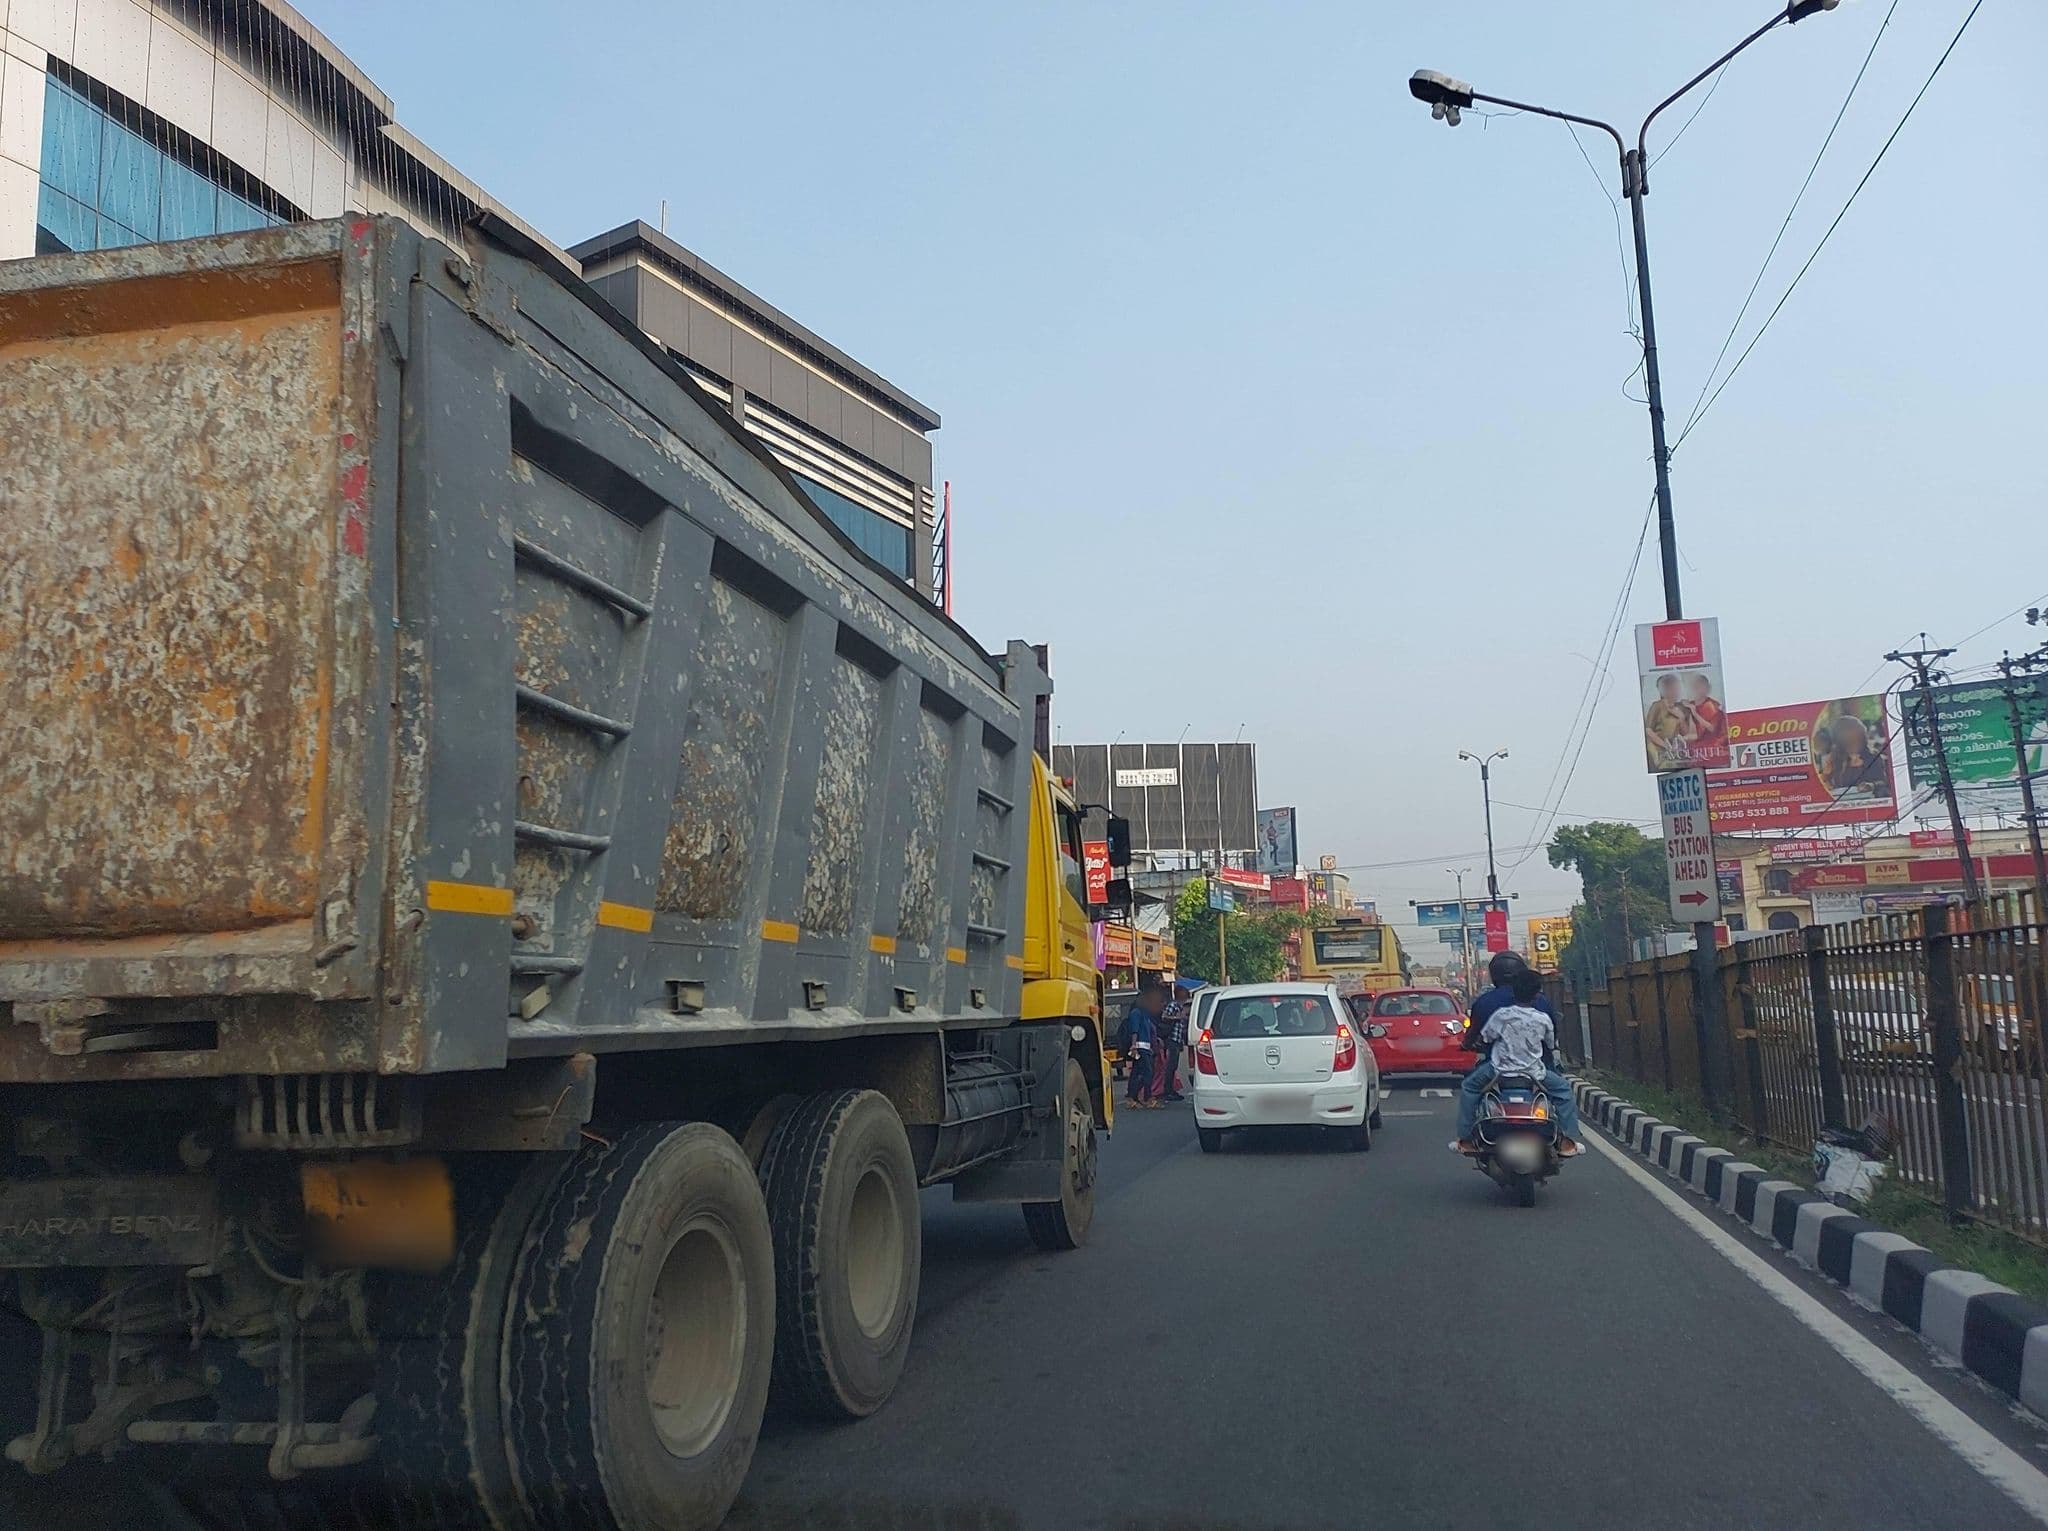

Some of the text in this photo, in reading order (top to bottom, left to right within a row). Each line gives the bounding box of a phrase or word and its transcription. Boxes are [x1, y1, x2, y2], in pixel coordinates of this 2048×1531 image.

[1658, 644, 1699, 659] options
[1757, 738, 1808, 756] GEEBEE
[1759, 755, 1808, 767] EDUCATION
[1660, 774, 1700, 800] KSRTC
[1664, 798, 1703, 816] ANKAMALY
[1747, 808, 1767, 818] 533
[1673, 815, 1693, 836] BUS
[1667, 836, 1710, 859] STATION
[1674, 859, 1708, 882] AHEAD
[1875, 864, 1900, 873] ATM
